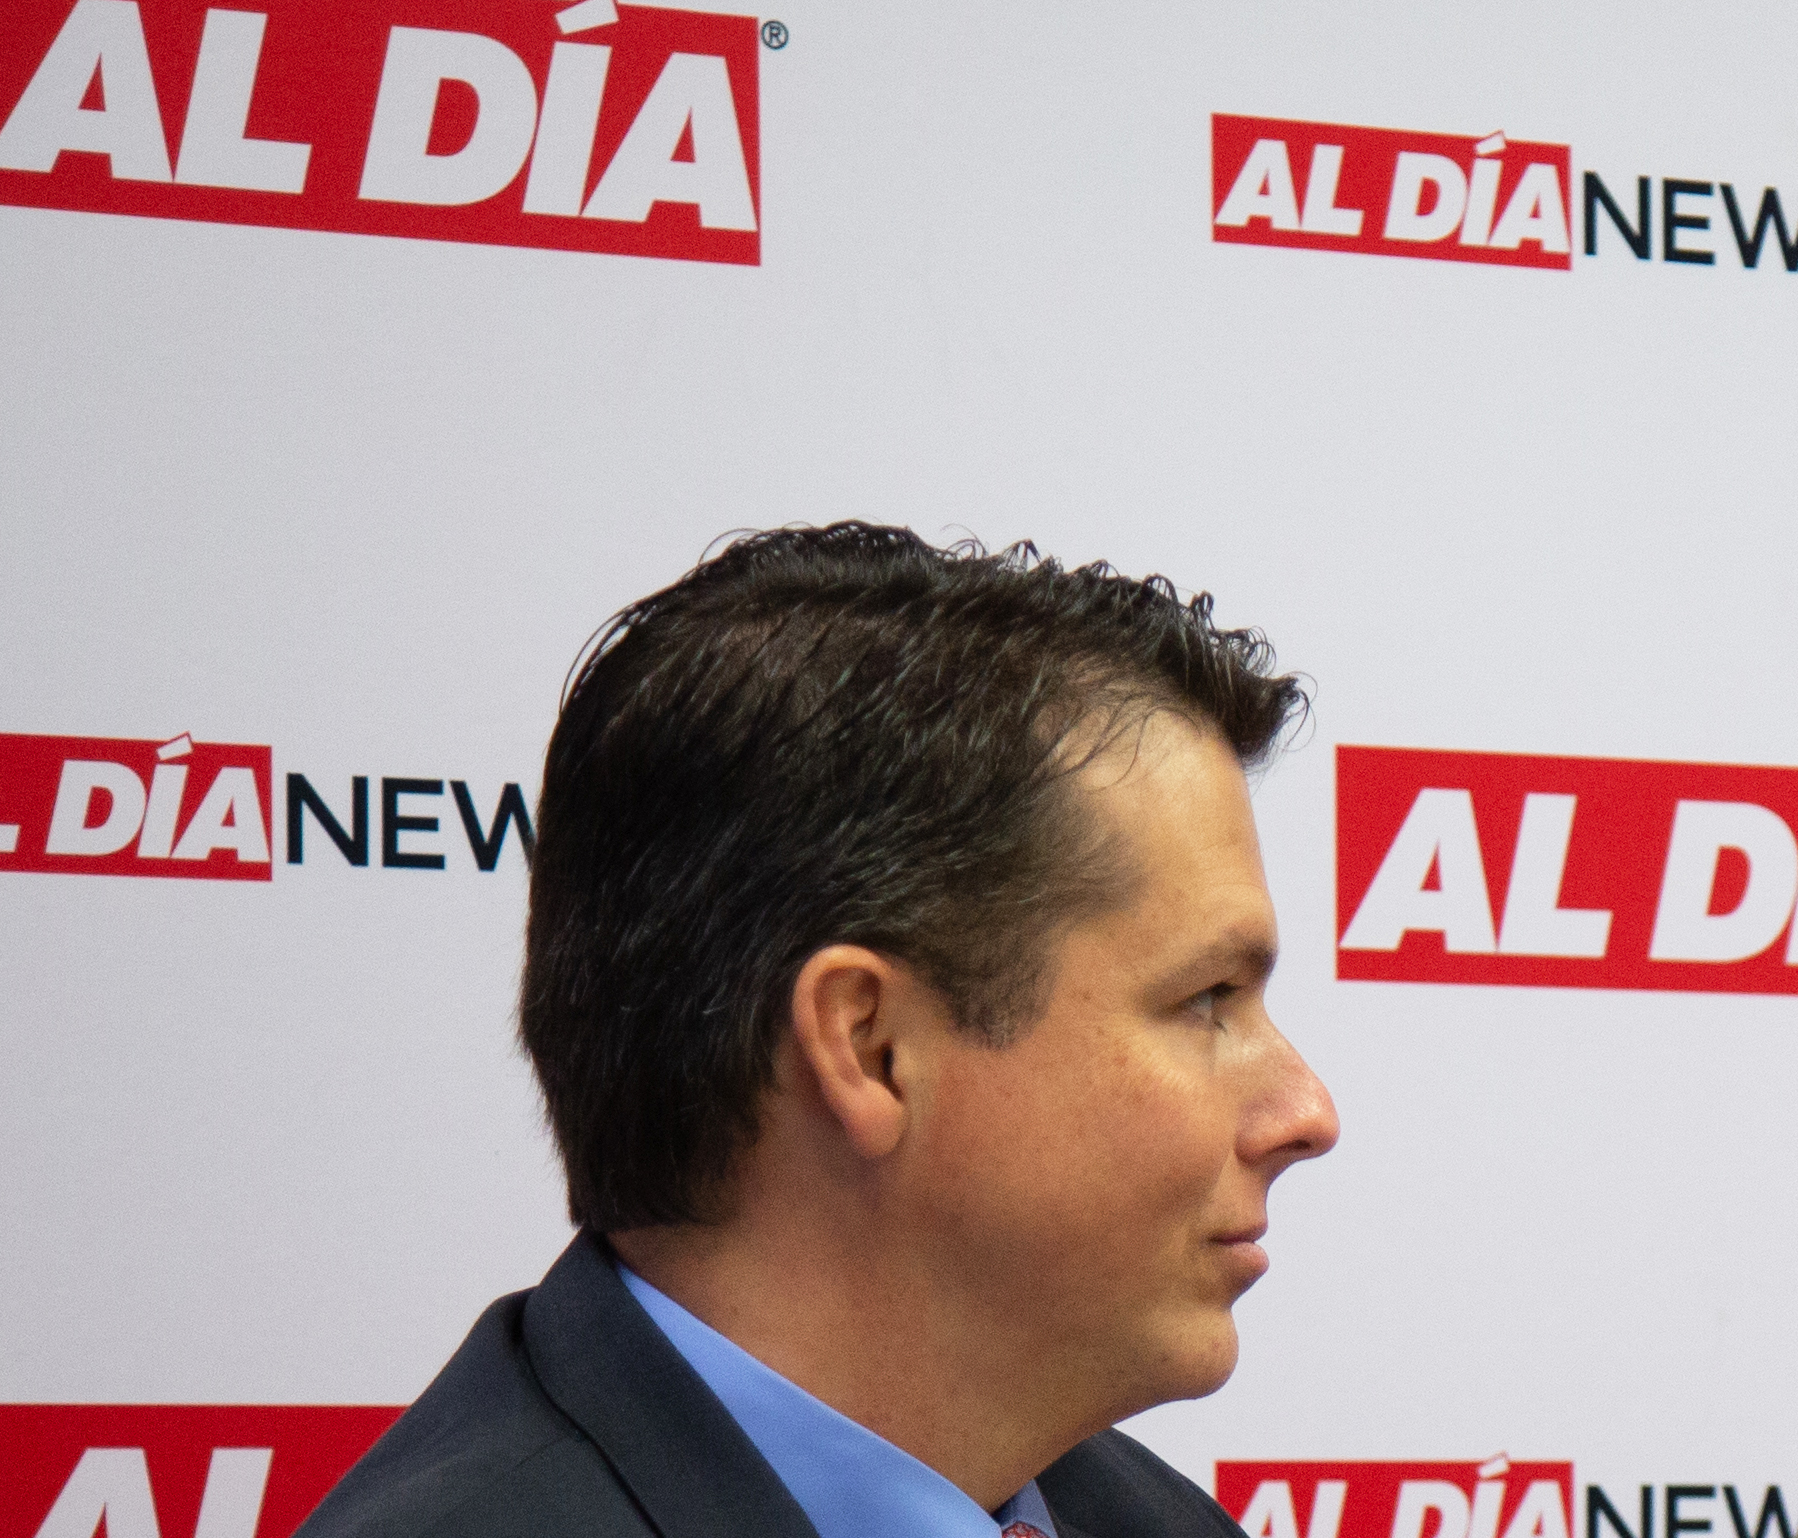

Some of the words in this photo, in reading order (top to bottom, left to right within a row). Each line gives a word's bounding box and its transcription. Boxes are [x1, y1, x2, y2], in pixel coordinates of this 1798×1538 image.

[0, 0, 312, 194] AL
[358, 0, 758, 232] DÍA
[1215, 138, 1365, 238] AL
[45, 732, 271, 863] DÍA
[286, 772, 540, 872] NEW
[1338, 788, 1614, 958] AL
